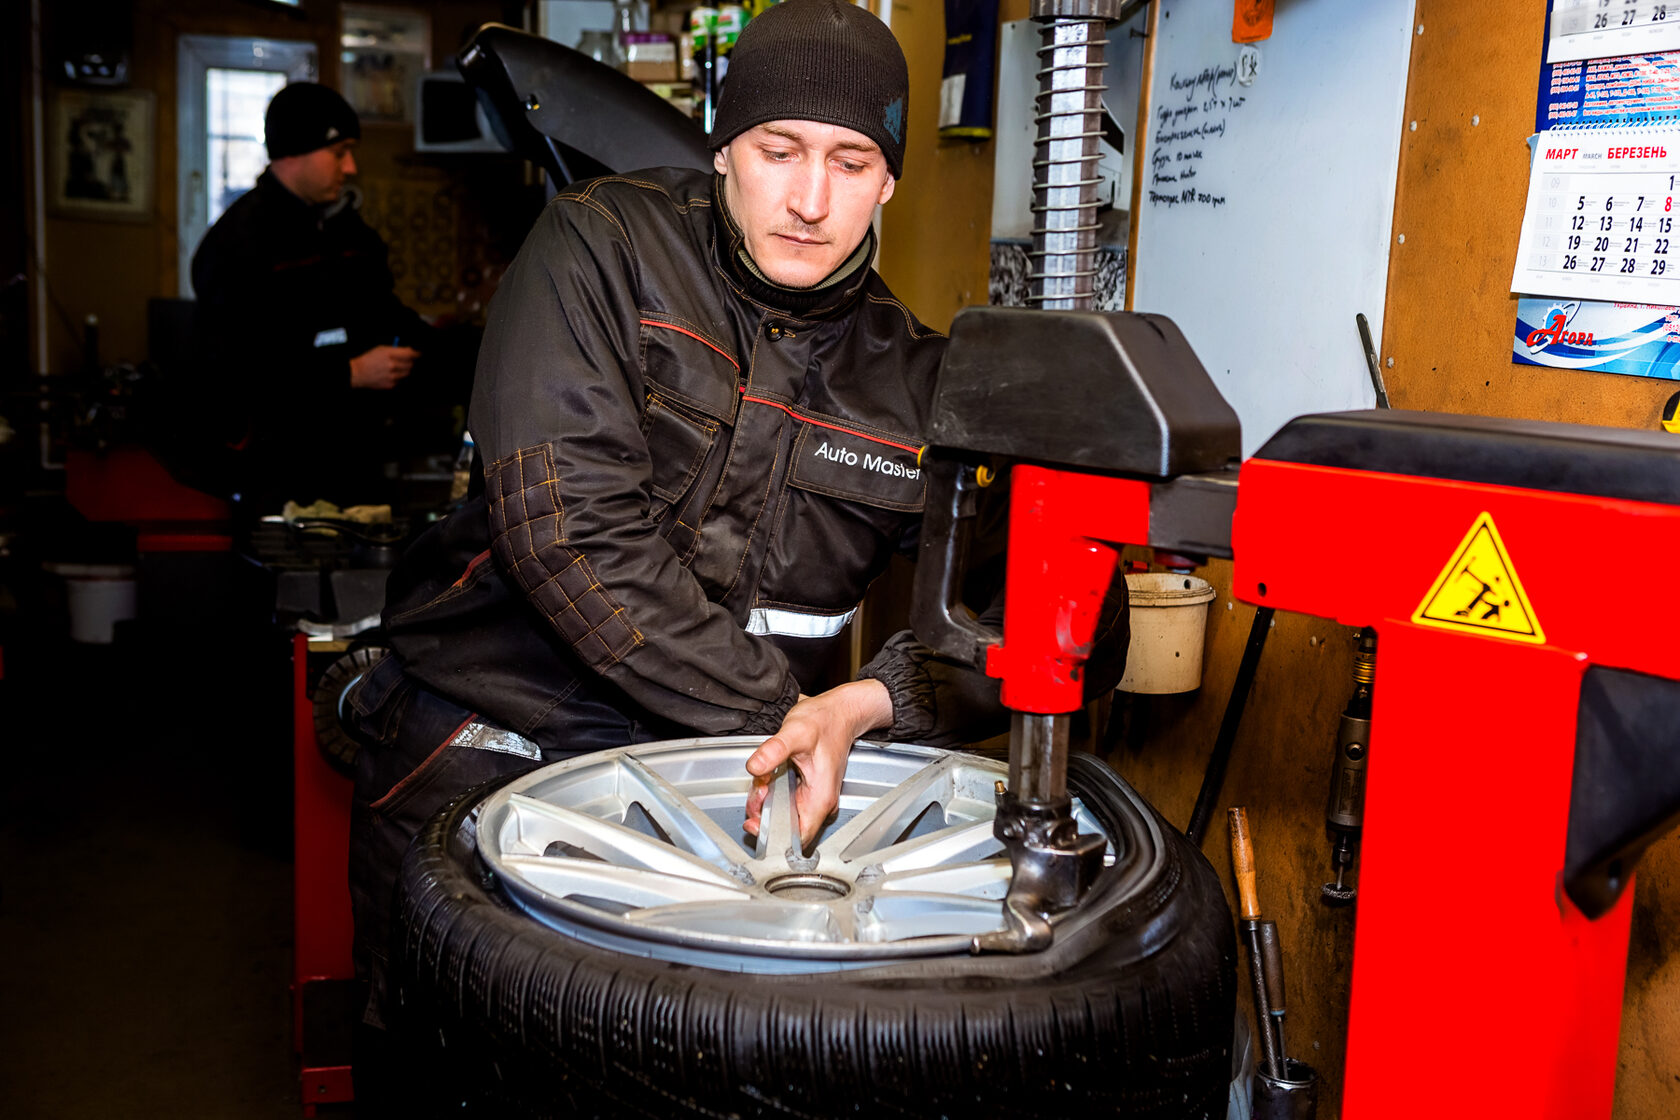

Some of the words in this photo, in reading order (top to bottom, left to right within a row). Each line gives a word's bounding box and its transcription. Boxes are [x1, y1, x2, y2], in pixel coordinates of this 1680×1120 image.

[1594, 13, 1608, 28] 26
[1622, 9, 1637, 26] 27
[1652, 5, 1667, 21] 28
[1545, 148, 1579, 160] МАРТ
[1607, 146, 1667, 159] БЕРЕЗЕНЬ
[1669, 175, 1675, 191] 1
[1577, 196, 1585, 210] 5
[1605, 196, 1613, 212] 6
[1636, 196, 1644, 212] 7
[1664, 196, 1672, 212] 8
[1572, 215, 1585, 230] 12
[1600, 216, 1613, 231] 13
[1630, 217, 1643, 232] 14
[1659, 217, 1672, 233] 15
[1568, 235, 1581, 250] 19
[1594, 236, 1609, 252] 20
[1624, 237, 1638, 253] 21
[1654, 238, 1669, 254] 22
[1563, 255, 1577, 270] 26
[1590, 256, 1605, 272] 27
[1620, 258, 1635, 273] 28
[1650, 259, 1666, 275] 29
[814, 441, 858, 466] Auto
[862, 453, 921, 480] Master
